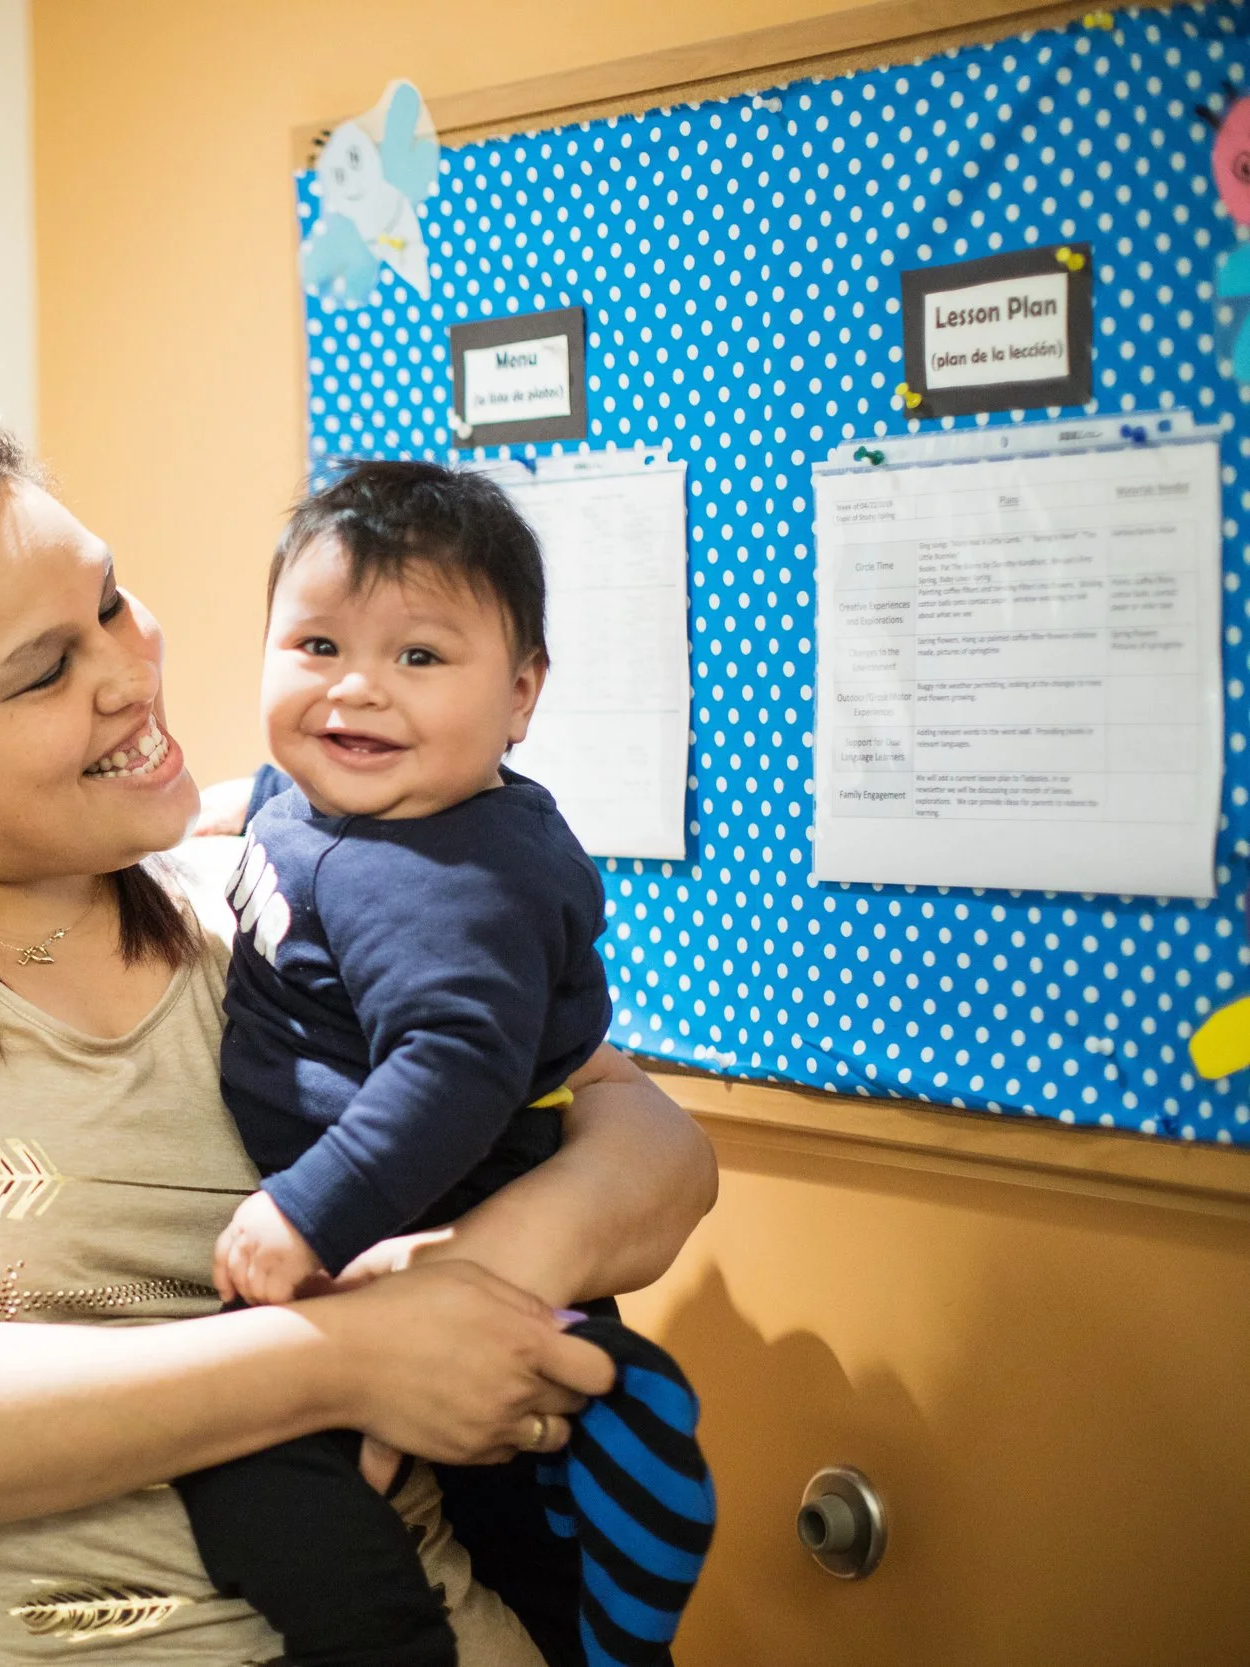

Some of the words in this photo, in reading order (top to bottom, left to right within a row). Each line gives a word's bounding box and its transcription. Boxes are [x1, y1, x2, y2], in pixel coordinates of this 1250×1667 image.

[935, 303, 1000, 329] Lesson
[1007, 296, 1057, 320] Plan
[495, 351, 538, 370] Menu
[931, 351, 967, 372] (plan
[971, 347, 987, 363] de
[992, 345, 1005, 362] la
[1009, 340, 1064, 361] lección)
[855, 562, 875, 572] Circle
[876, 561, 894, 571] Time
[839, 602, 868, 612] Creative
[870, 600, 911, 612] Experiences
[860, 616, 904, 627] Explorations
[888, 647, 901, 656] the
[890, 692, 912, 701] Motor
[845, 737, 872, 748] Support
[874, 738, 884, 747] for
[841, 753, 874, 763] Language
[875, 753, 906, 762] Learners
[840, 791, 862, 801] Family
[863, 790, 906, 802] Engagement
